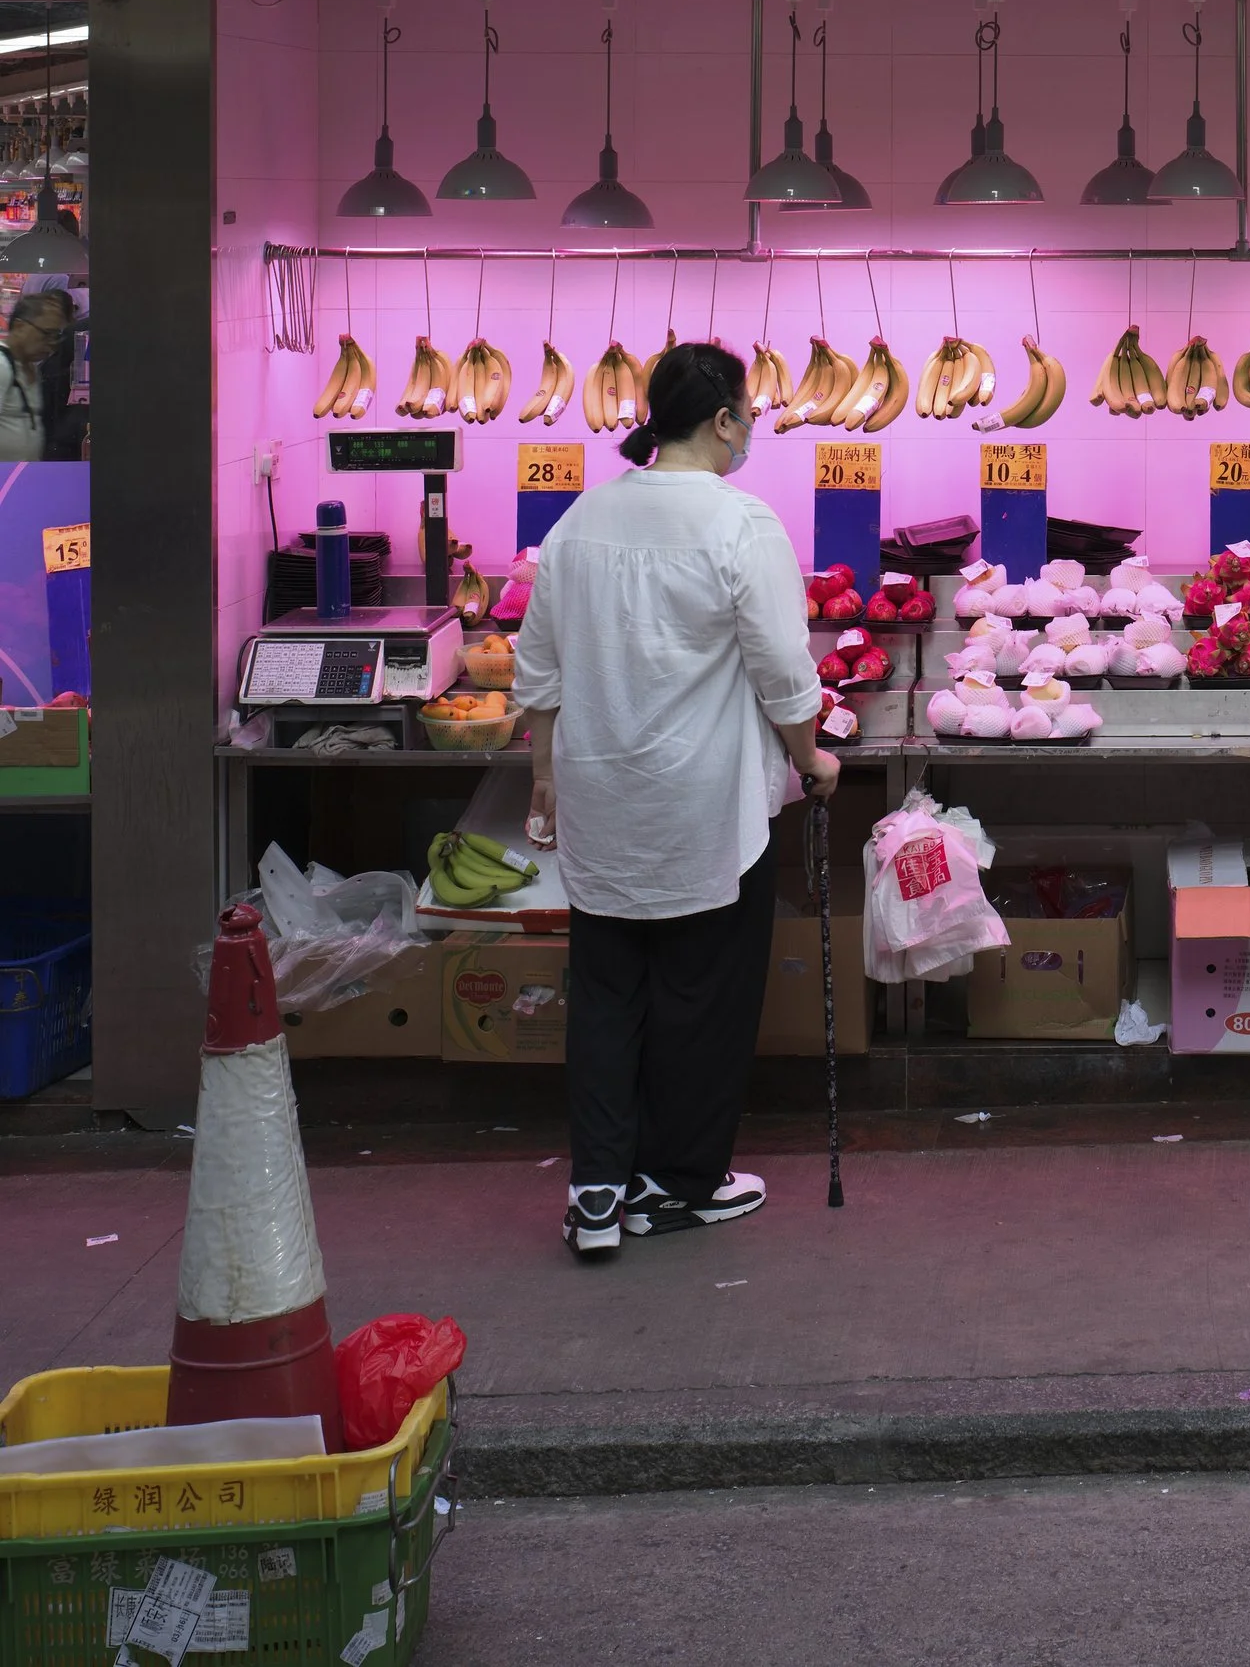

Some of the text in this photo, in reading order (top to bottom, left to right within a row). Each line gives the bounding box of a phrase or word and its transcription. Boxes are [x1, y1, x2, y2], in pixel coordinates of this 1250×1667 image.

[828, 446, 877, 462] 加納果
[993, 445, 1043, 460] 鴨梨
[902, 844, 921, 854] KAI
[92, 1480, 245, 1516] 绿润公司
[220, 1545, 248, 1560] 136
[219, 1563, 248, 1579] 966
